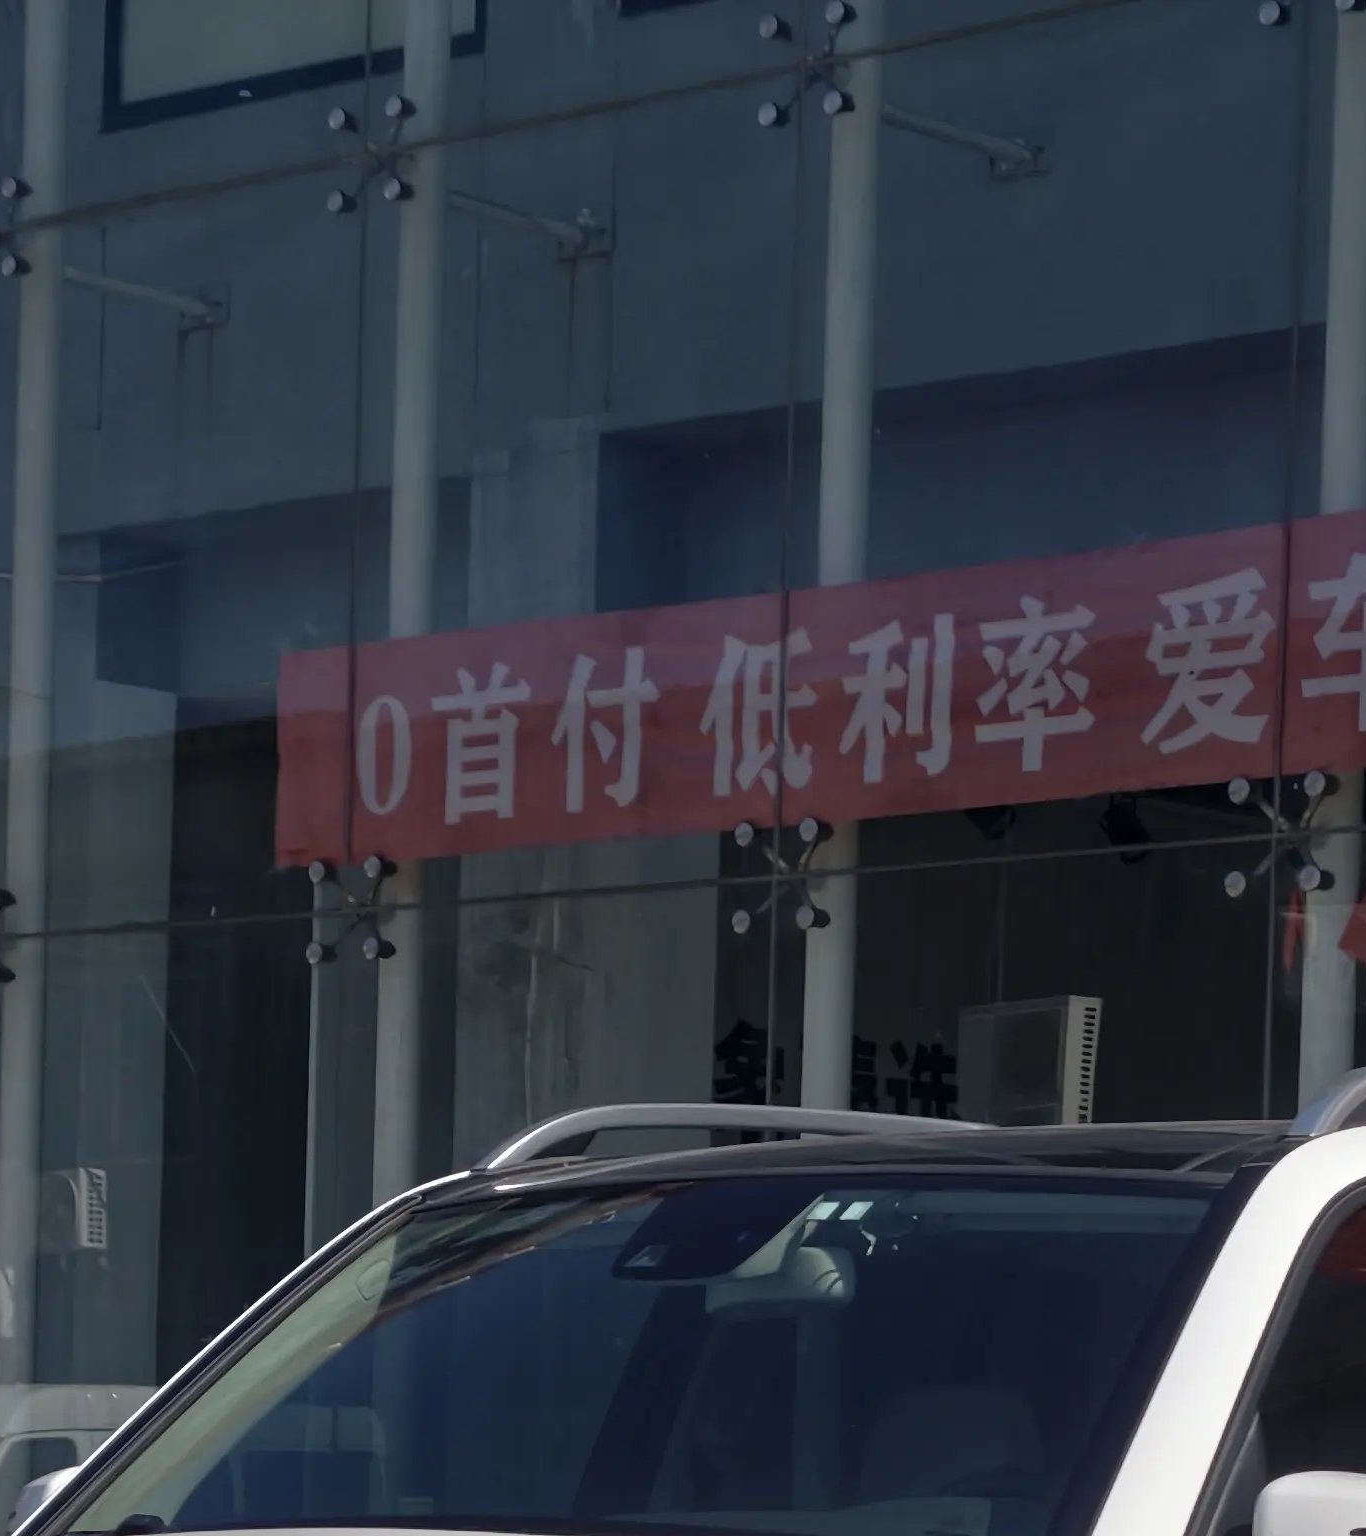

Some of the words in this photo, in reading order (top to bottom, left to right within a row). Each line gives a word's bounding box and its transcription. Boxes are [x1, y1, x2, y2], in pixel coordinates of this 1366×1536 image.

[356, 645, 659, 825] 0首付
[699, 596, 1096, 798] 低利率
